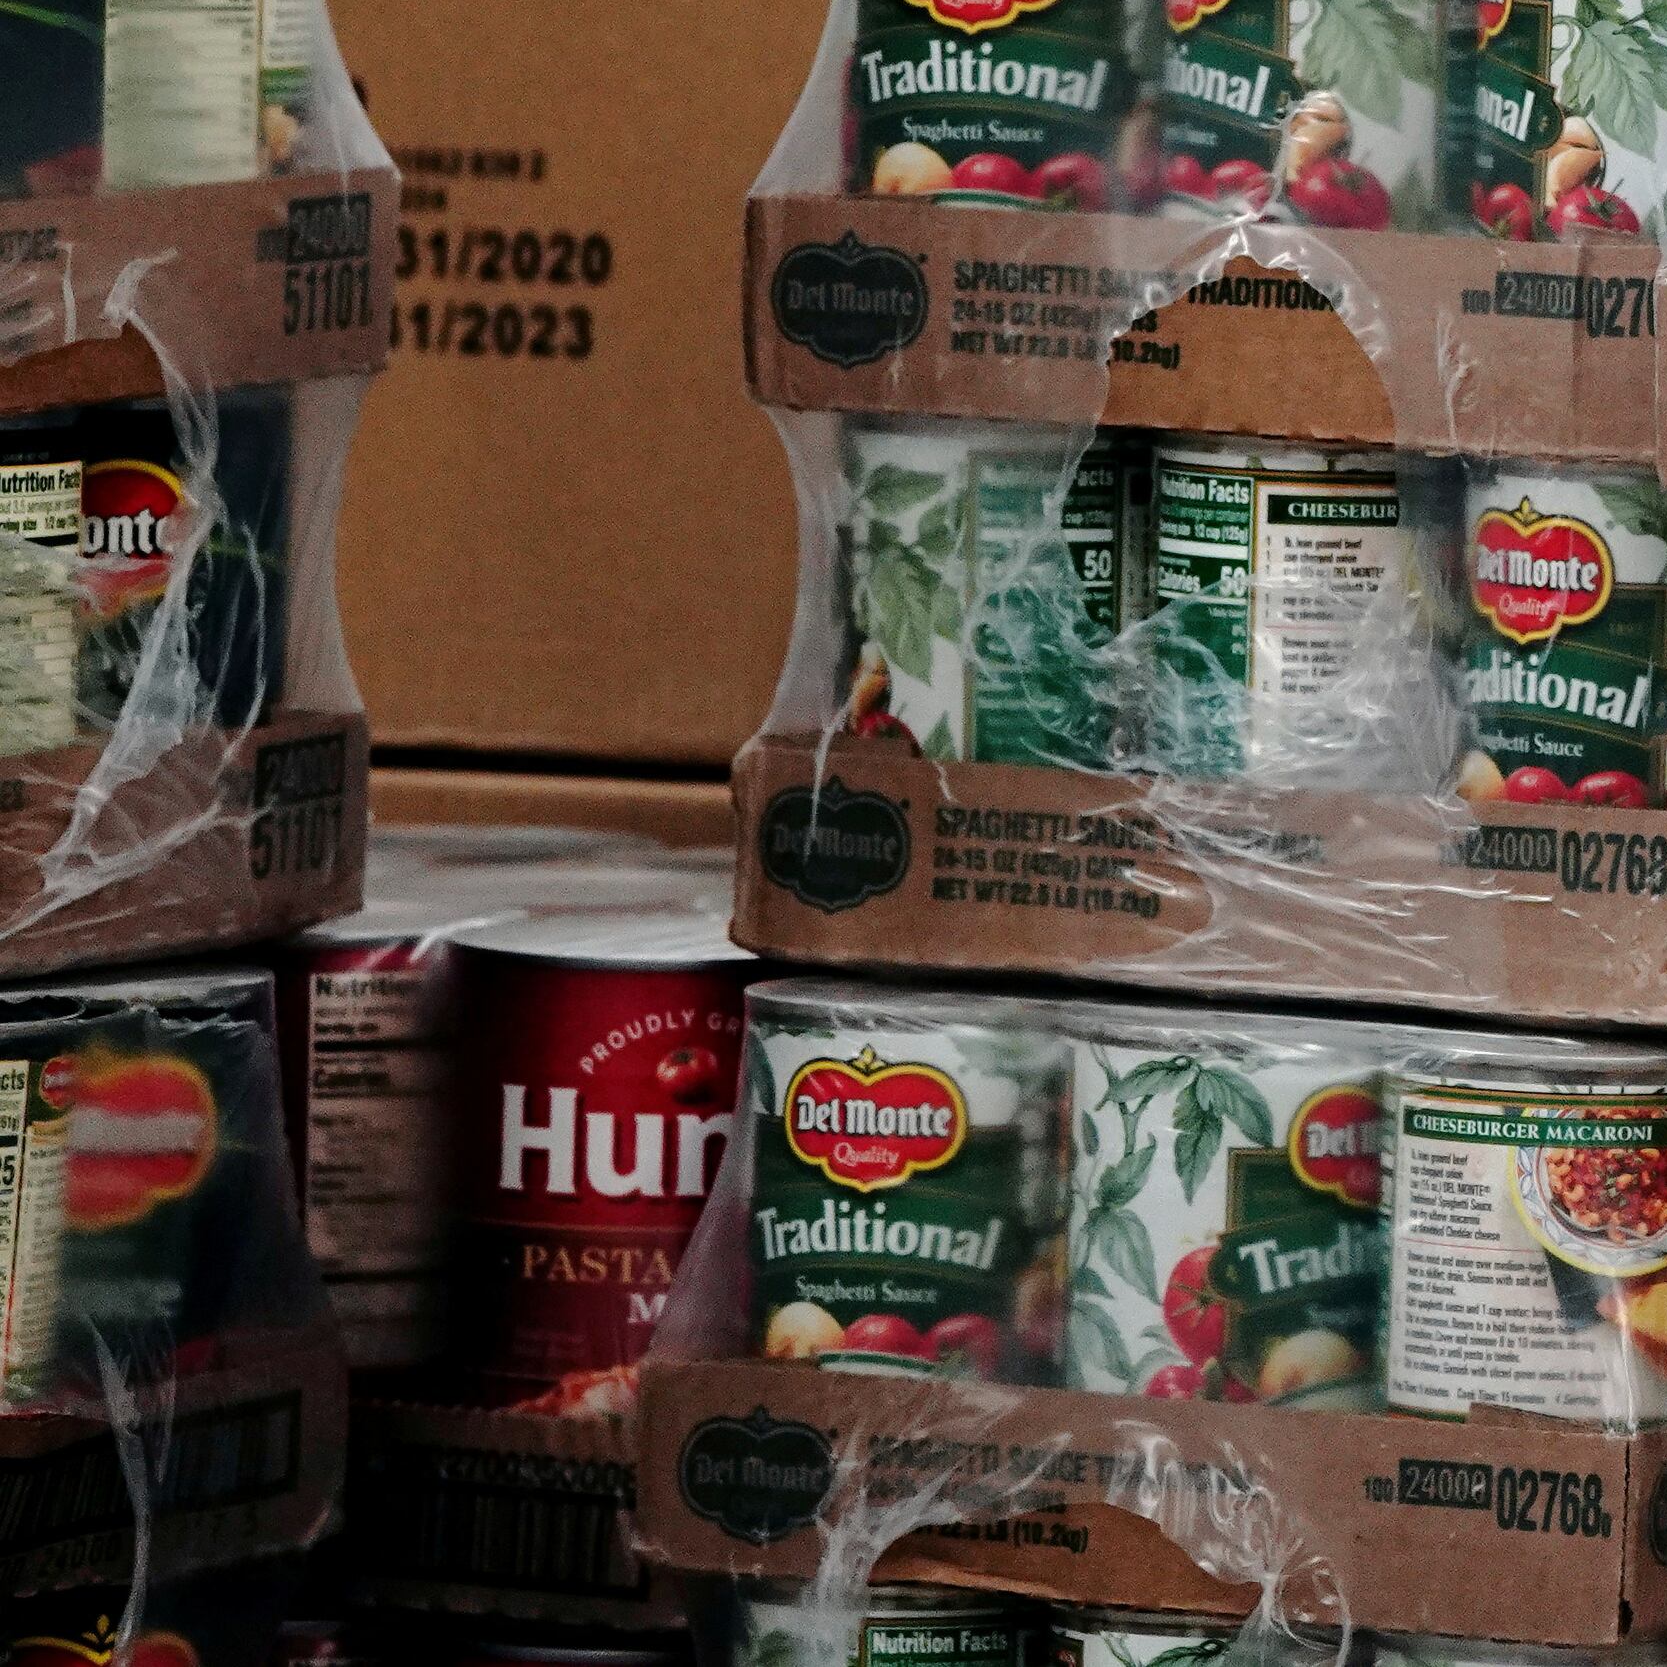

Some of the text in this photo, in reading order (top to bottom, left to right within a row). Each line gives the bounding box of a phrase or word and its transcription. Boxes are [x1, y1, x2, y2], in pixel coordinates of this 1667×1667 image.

[860, 39, 1112, 113] Traditional
[0, 472, 55, 494] utrition
[1208, 476, 1250, 505] Facts
[1082, 549, 1111, 581] 50
[1507, 549, 1600, 593] Monte
[1499, 592, 1551, 622] Quality
[1533, 733, 1585, 758] Sauce
[579, 1007, 697, 1075] PROUDLY
[796, 1095, 953, 1138] Del Monte
[1412, 1112, 1653, 1143] CHEESEBURGER MACARONI
[831, 1140, 901, 1170] Quality
[756, 1196, 1005, 1272] Traditional
[522, 1243, 676, 1286] PASTA
[872, 1631, 955, 1655] Nutrition
